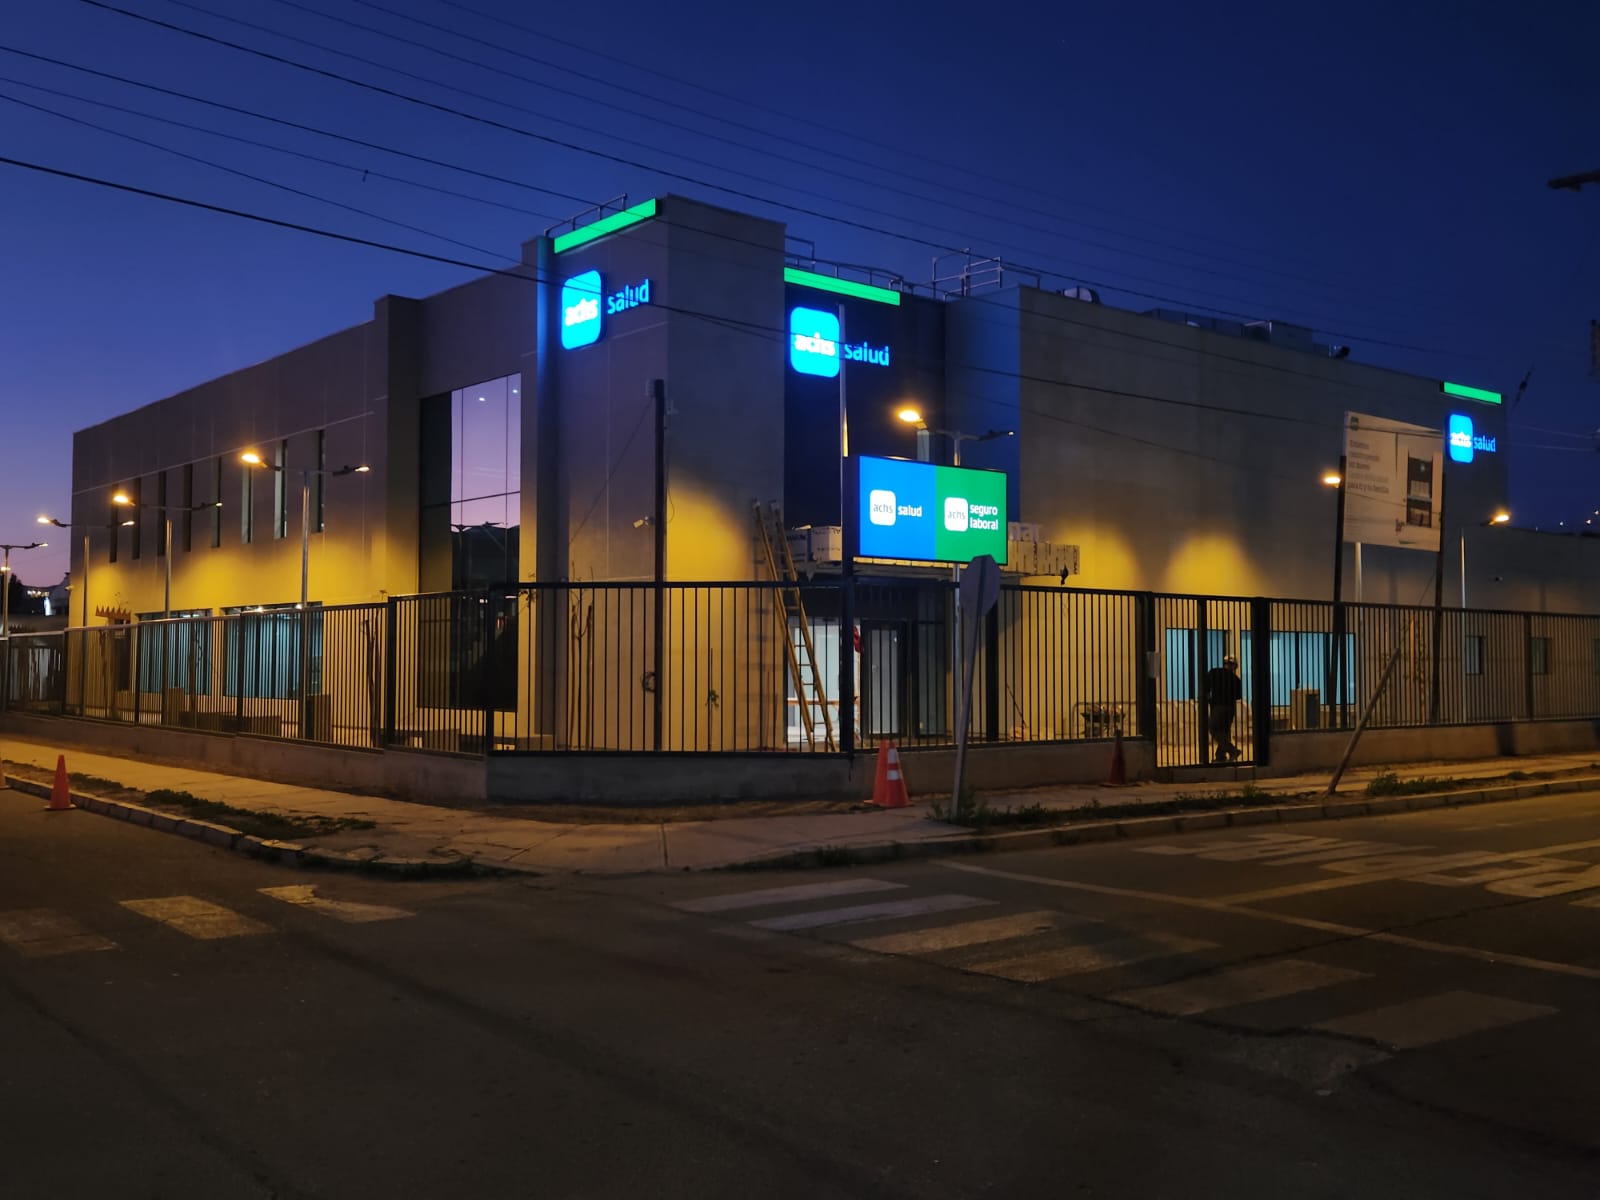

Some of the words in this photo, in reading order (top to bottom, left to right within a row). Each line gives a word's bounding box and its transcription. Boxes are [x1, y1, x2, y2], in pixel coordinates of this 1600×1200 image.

[607, 278, 649, 315] salud
[844, 341, 890, 367] salud
[1473, 435, 1496, 453] salud
[873, 503, 894, 514] achs
[897, 504, 923, 518] salud
[947, 510, 966, 520] achs
[969, 504, 998, 517] seguro
[969, 518, 999, 531] laboral
